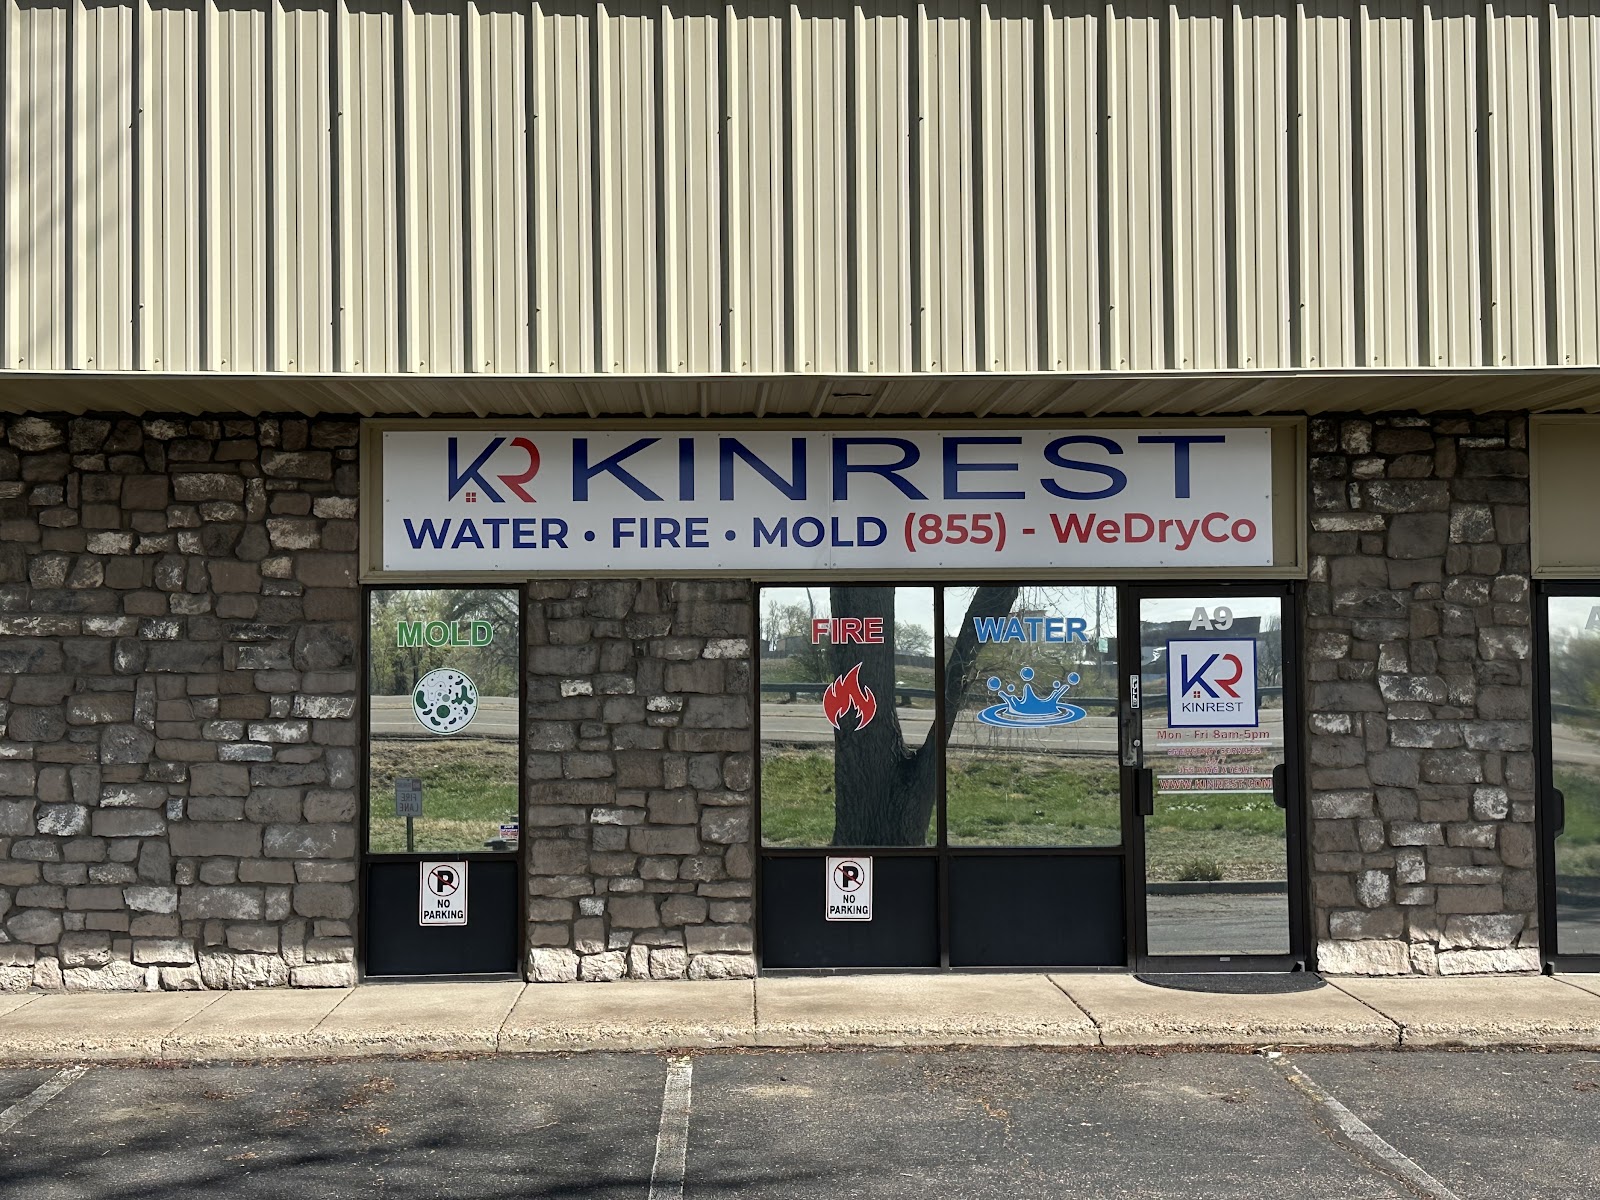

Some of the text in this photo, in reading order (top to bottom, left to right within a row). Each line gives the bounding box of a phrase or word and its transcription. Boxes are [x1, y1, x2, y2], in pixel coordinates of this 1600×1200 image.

[572, 435, 1226, 501] KINREST
[403, 518, 569, 549] WATER
[612, 517, 709, 548] FIRE
[752, 516, 888, 548] MOLD
[904, 512, 1008, 552] (855)
[1049, 512, 1257, 551] WeDryCo
[1188, 606, 1234, 631] A9
[397, 620, 494, 648] MOLD
[811, 617, 885, 645] FIRE
[973, 617, 1090, 644] WATER
[1182, 702, 1244, 712] KINREST
[1157, 730, 1182, 739] Mon
[1194, 730, 1209, 739] Fri
[1213, 729, 1270, 740] 8am-5pm
[437, 899, 450, 908] NO
[843, 895, 856, 903] NO
[423, 910, 464, 920] PARKING
[829, 905, 869, 914] PARKING
